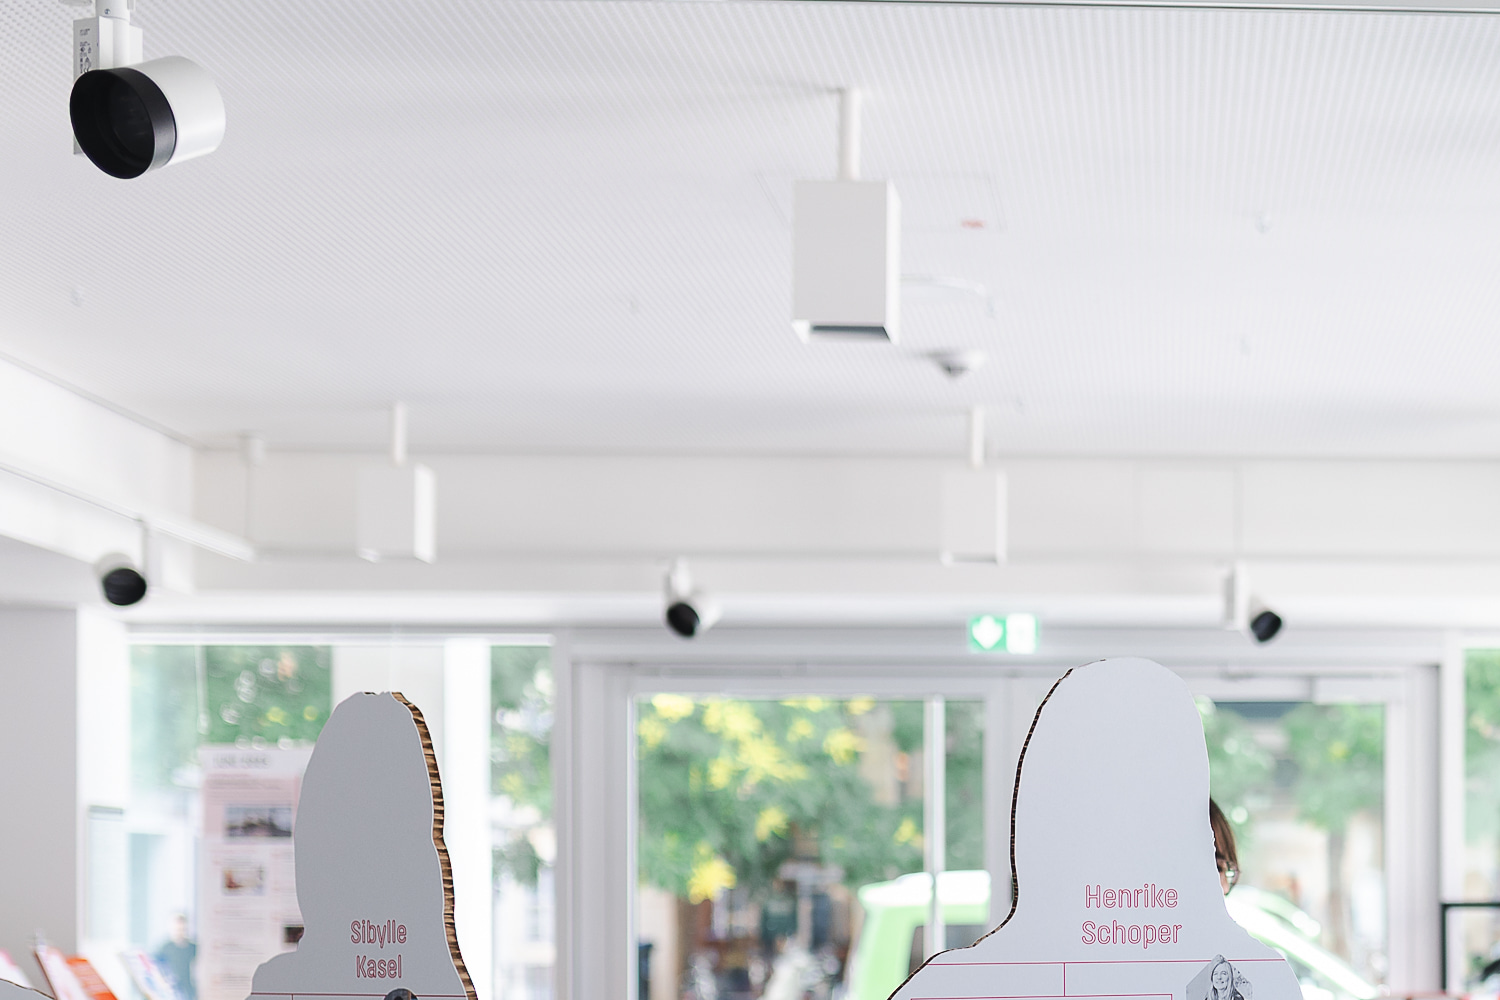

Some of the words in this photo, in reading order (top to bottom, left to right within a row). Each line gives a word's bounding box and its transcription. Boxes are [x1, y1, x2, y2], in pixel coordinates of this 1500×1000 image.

[1086, 884, 1178, 909] Henrike
[351, 919, 407, 948] Sibylle
[1082, 920, 1182, 948] Schoper
[356, 956, 402, 978] Kasel
